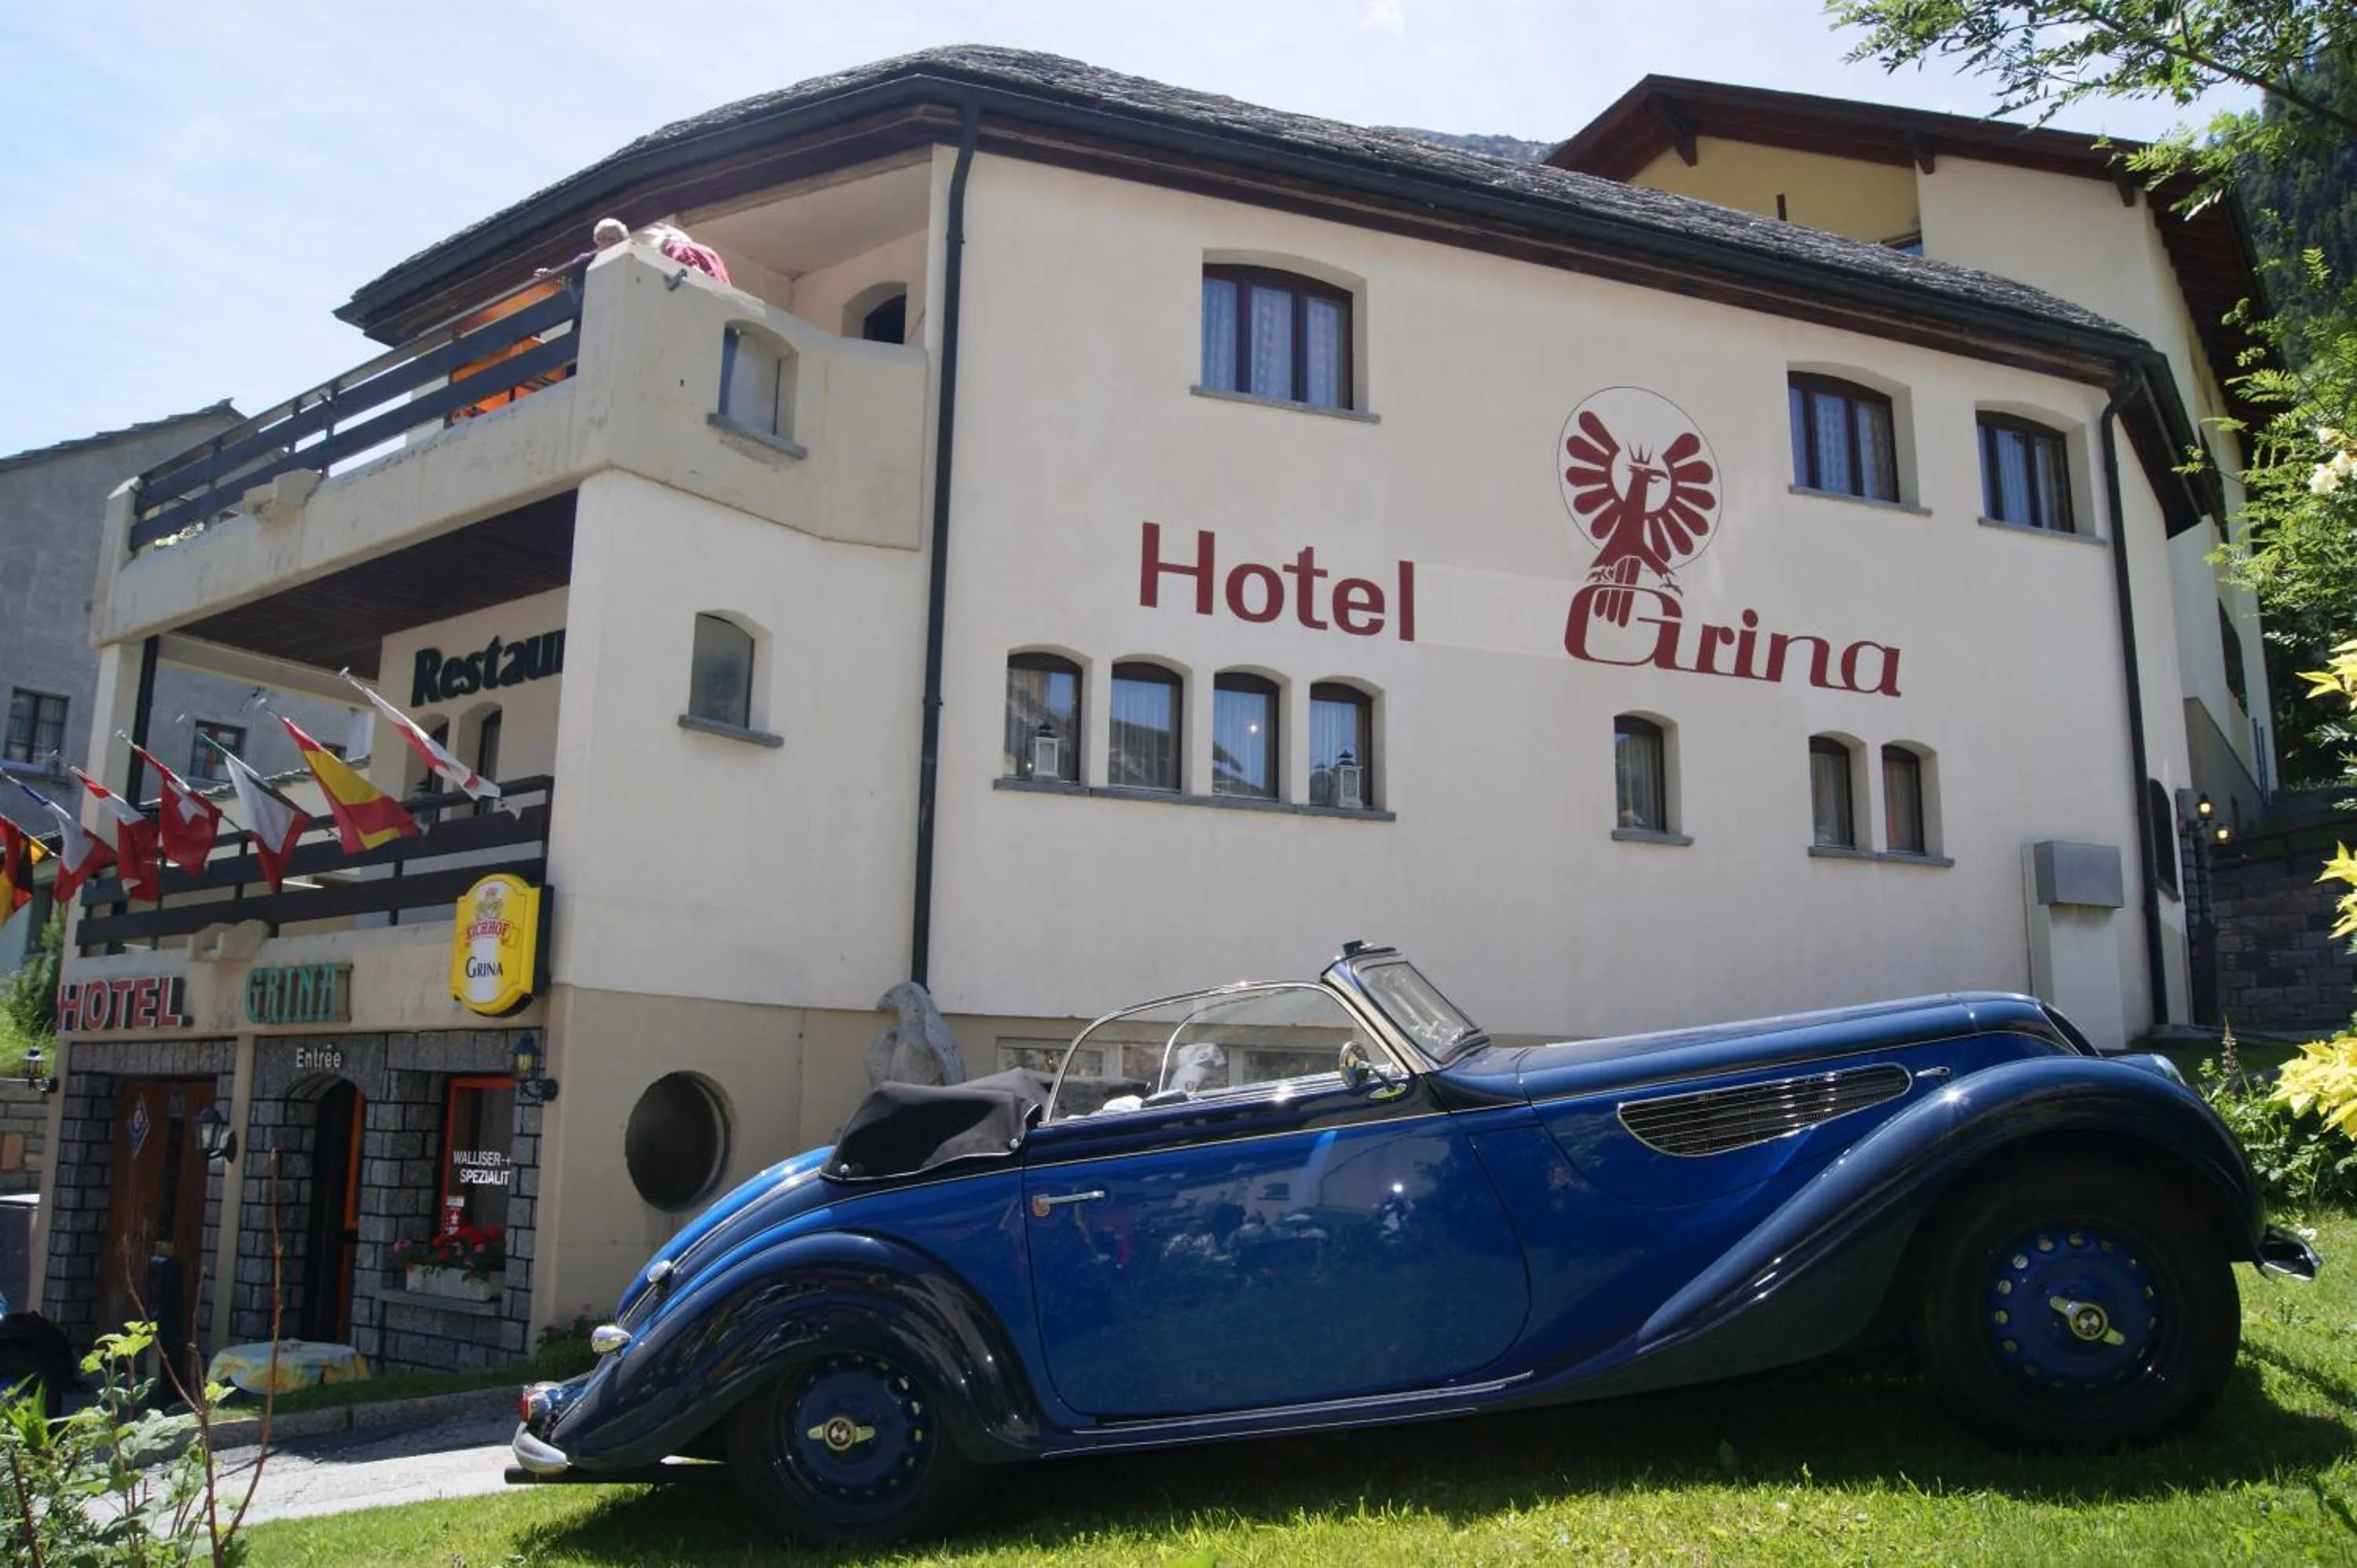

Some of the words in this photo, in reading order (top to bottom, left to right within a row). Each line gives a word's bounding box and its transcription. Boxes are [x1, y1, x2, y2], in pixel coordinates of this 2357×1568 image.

[1139, 520, 1415, 642] Hotel
[1564, 583, 1901, 698] Grina
[57, 976, 185, 1031] HOTEL
[244, 963, 339, 1024] GRINA
[295, 1045, 342, 1069] Entrée
